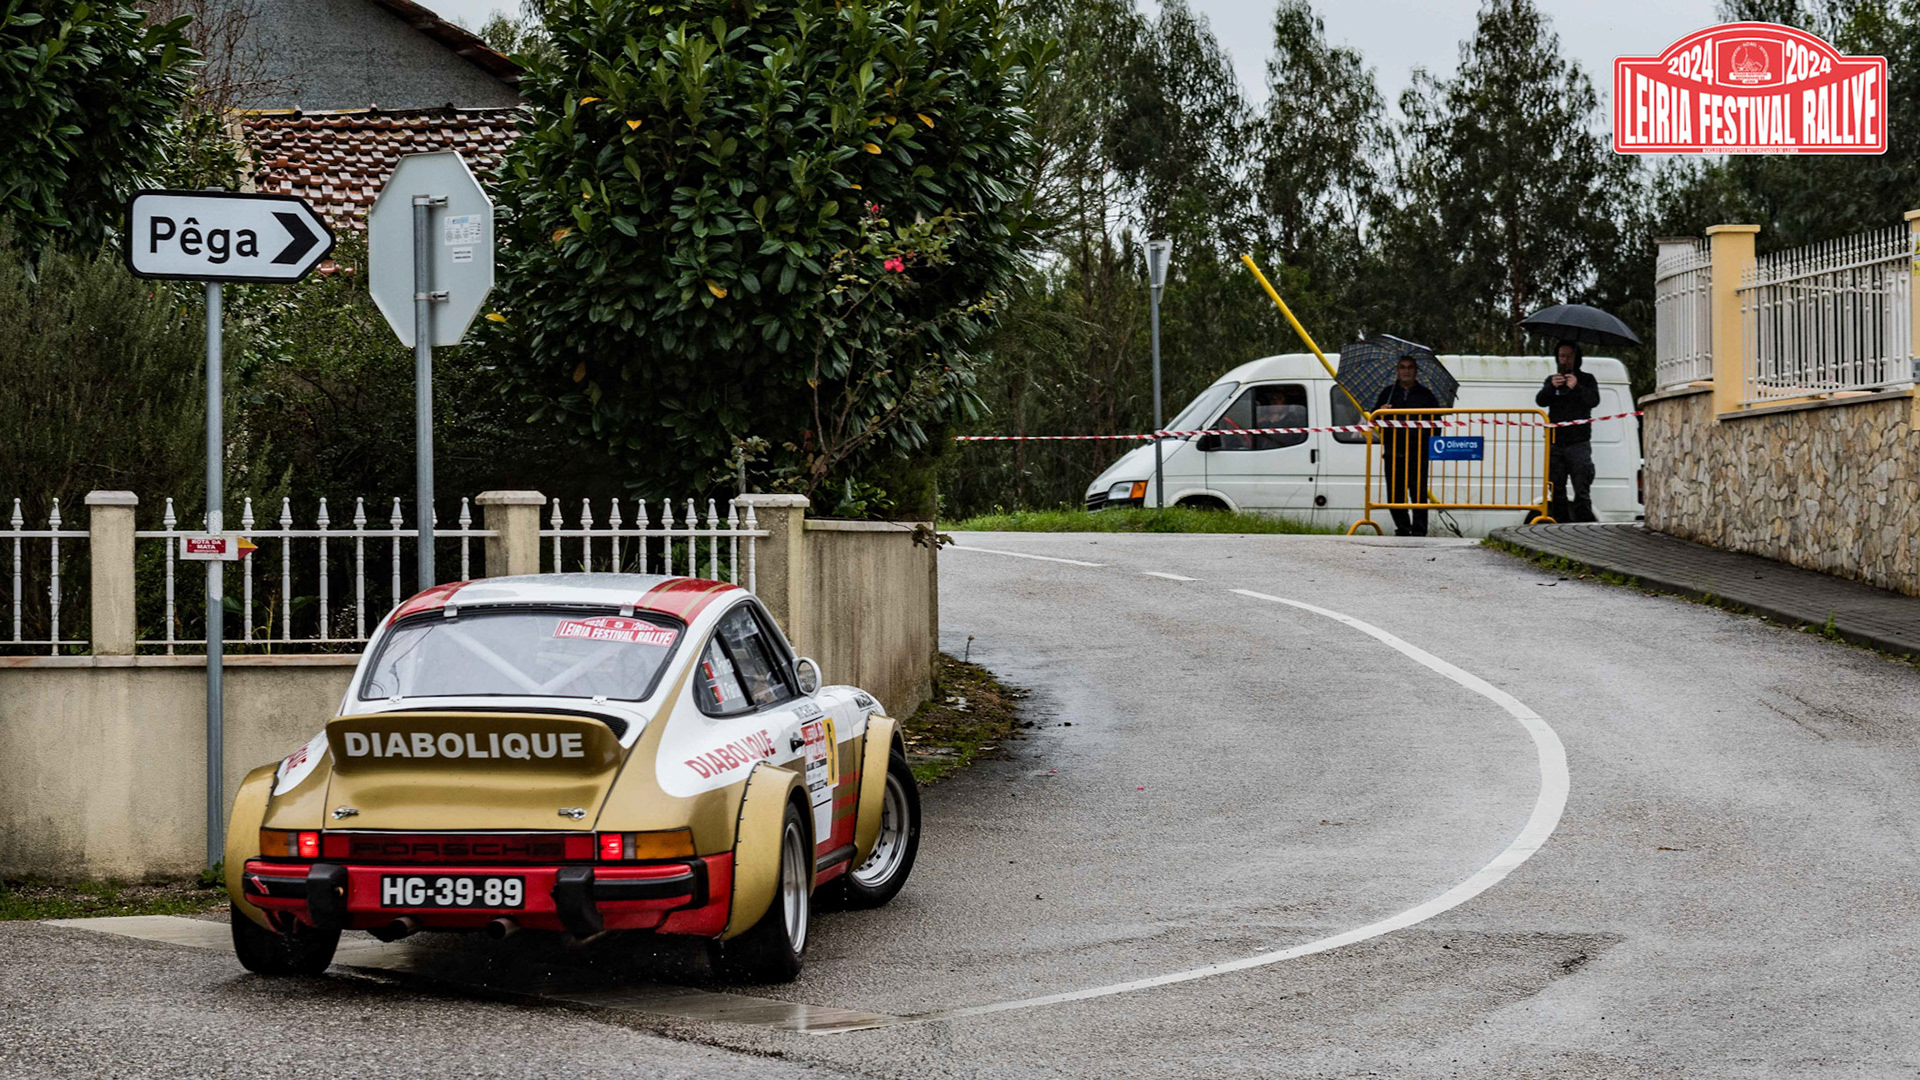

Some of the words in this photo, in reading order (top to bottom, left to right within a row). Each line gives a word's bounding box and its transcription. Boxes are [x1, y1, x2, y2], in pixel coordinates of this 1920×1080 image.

[149, 216, 259, 264] Pêga
[1446, 440, 1478, 448] Oliveiras
[560, 621, 590, 637] LEIRIA
[591, 628, 634, 641] FESTIVAL
[635, 631, 673, 645] RALLYE
[344, 732, 585, 760] DIABOLIQUE
[684, 729, 776, 779] DIABOLIQUE
[352, 842, 563, 856] PORSCHE
[382, 877, 523, 907] HG-39-89
